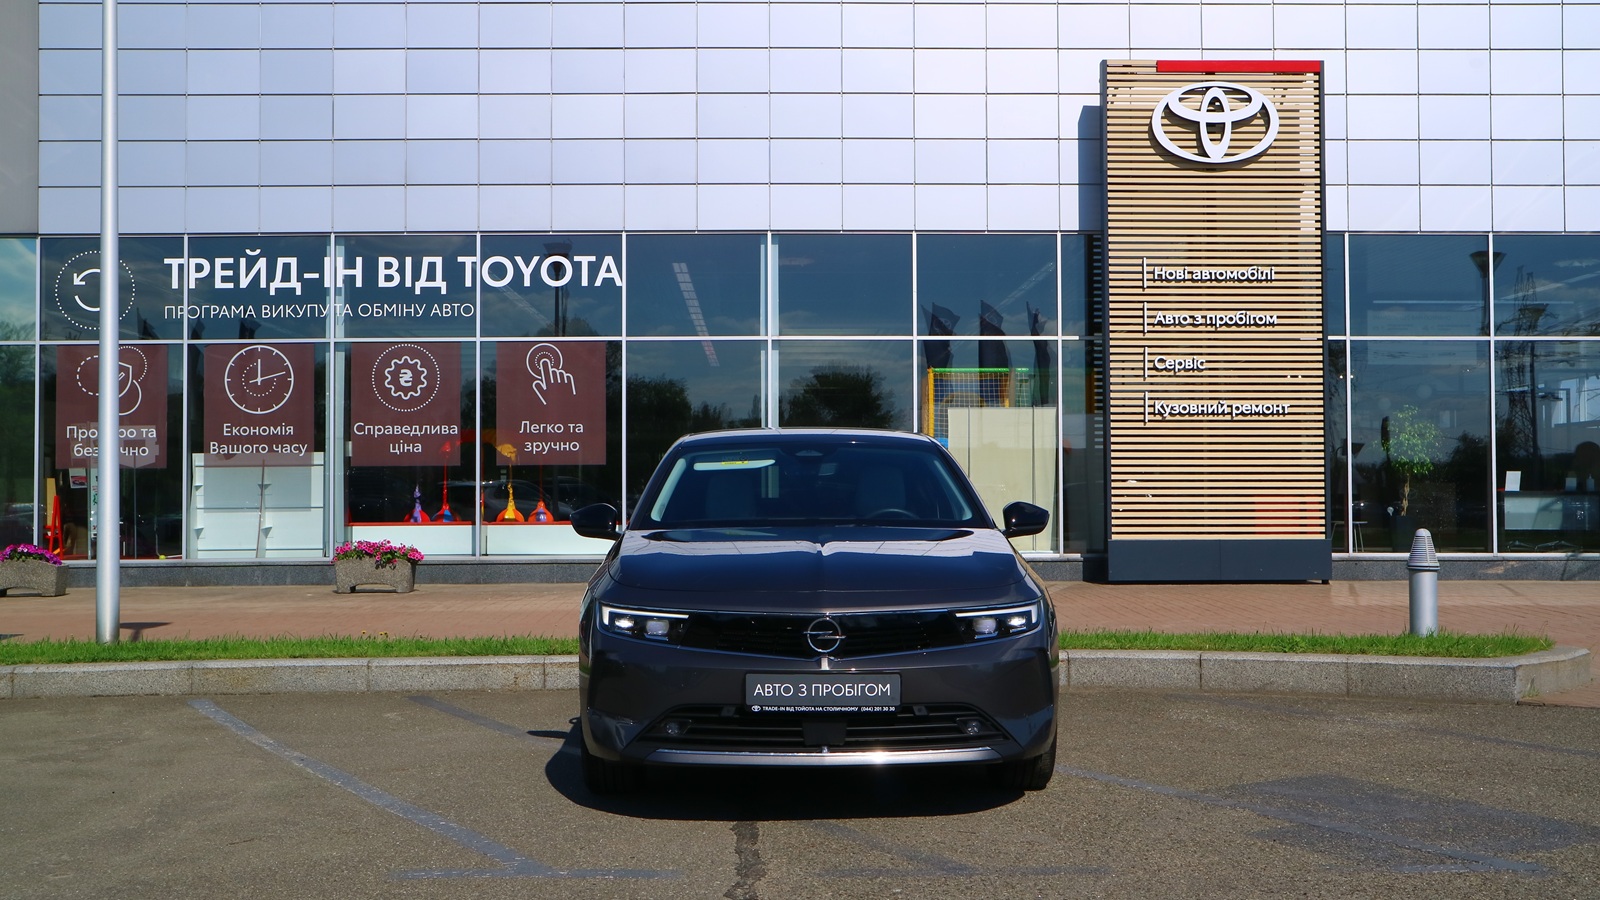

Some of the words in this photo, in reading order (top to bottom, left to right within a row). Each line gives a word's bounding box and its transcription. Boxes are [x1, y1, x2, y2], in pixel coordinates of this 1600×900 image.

[164, 249, 362, 295] ТРЕЙД-ІН
[378, 257, 447, 295] ВІД
[457, 256, 622, 287] TOYOTA
[1154, 266, 1188, 280] Нові
[1192, 266, 1275, 280] автомобілі
[164, 304, 256, 319] ПРОГРАМА
[262, 303, 330, 318] ВИКУПУ
[333, 304, 353, 317] ТА
[358, 303, 426, 317] ОБМІНУ
[430, 303, 474, 317] АВТО
[1154, 311, 1190, 325] Авто
[1194, 314, 1201, 325] з
[1206, 311, 1277, 327] пробігом
[1154, 356, 1206, 372] Сервіс
[1154, 400, 1228, 416] Кузовний
[1232, 403, 1290, 417] ремонт
[66, 425, 136, 441] Проро
[140, 428, 157, 437] та
[223, 423, 294, 436] Економія
[353, 423, 458, 437] Справедлива
[519, 421, 564, 434] Легко
[568, 423, 584, 434] та
[210, 442, 269, 454] Вашого
[273, 444, 308, 456] часу
[389, 440, 422, 453] ціна
[524, 441, 580, 454] зручно
[754, 684, 794, 696] АВТО
[812, 684, 891, 696] ПРОБІГОМ
